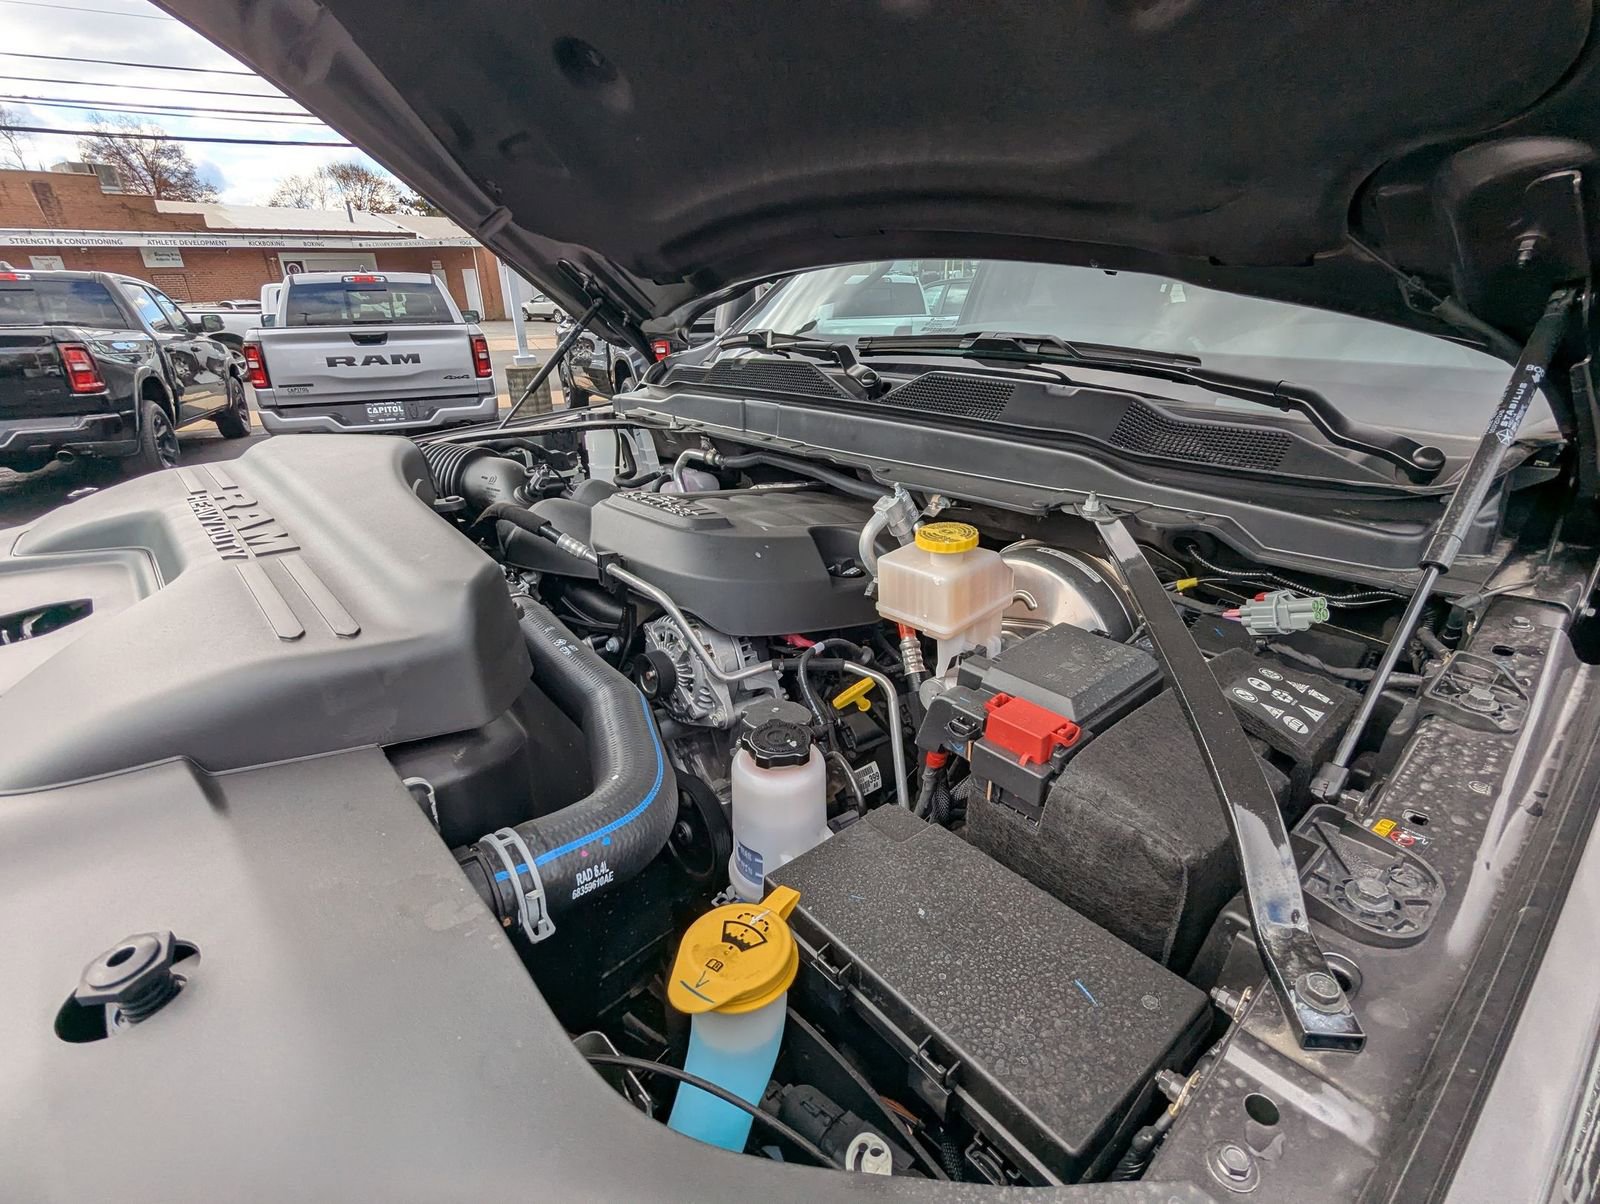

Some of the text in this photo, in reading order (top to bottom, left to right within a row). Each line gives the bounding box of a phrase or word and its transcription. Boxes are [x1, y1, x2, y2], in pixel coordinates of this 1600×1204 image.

[64, 238, 123, 246] CONDITIONING
[147, 239, 178, 247] ATHLETE
[326, 353, 421, 368] RAM
[367, 405, 404, 415] CAPITOL
[1500, 382, 1528, 428] STABILUS
[211, 486, 302, 557] RAM
[576, 868, 593, 886] RAD
